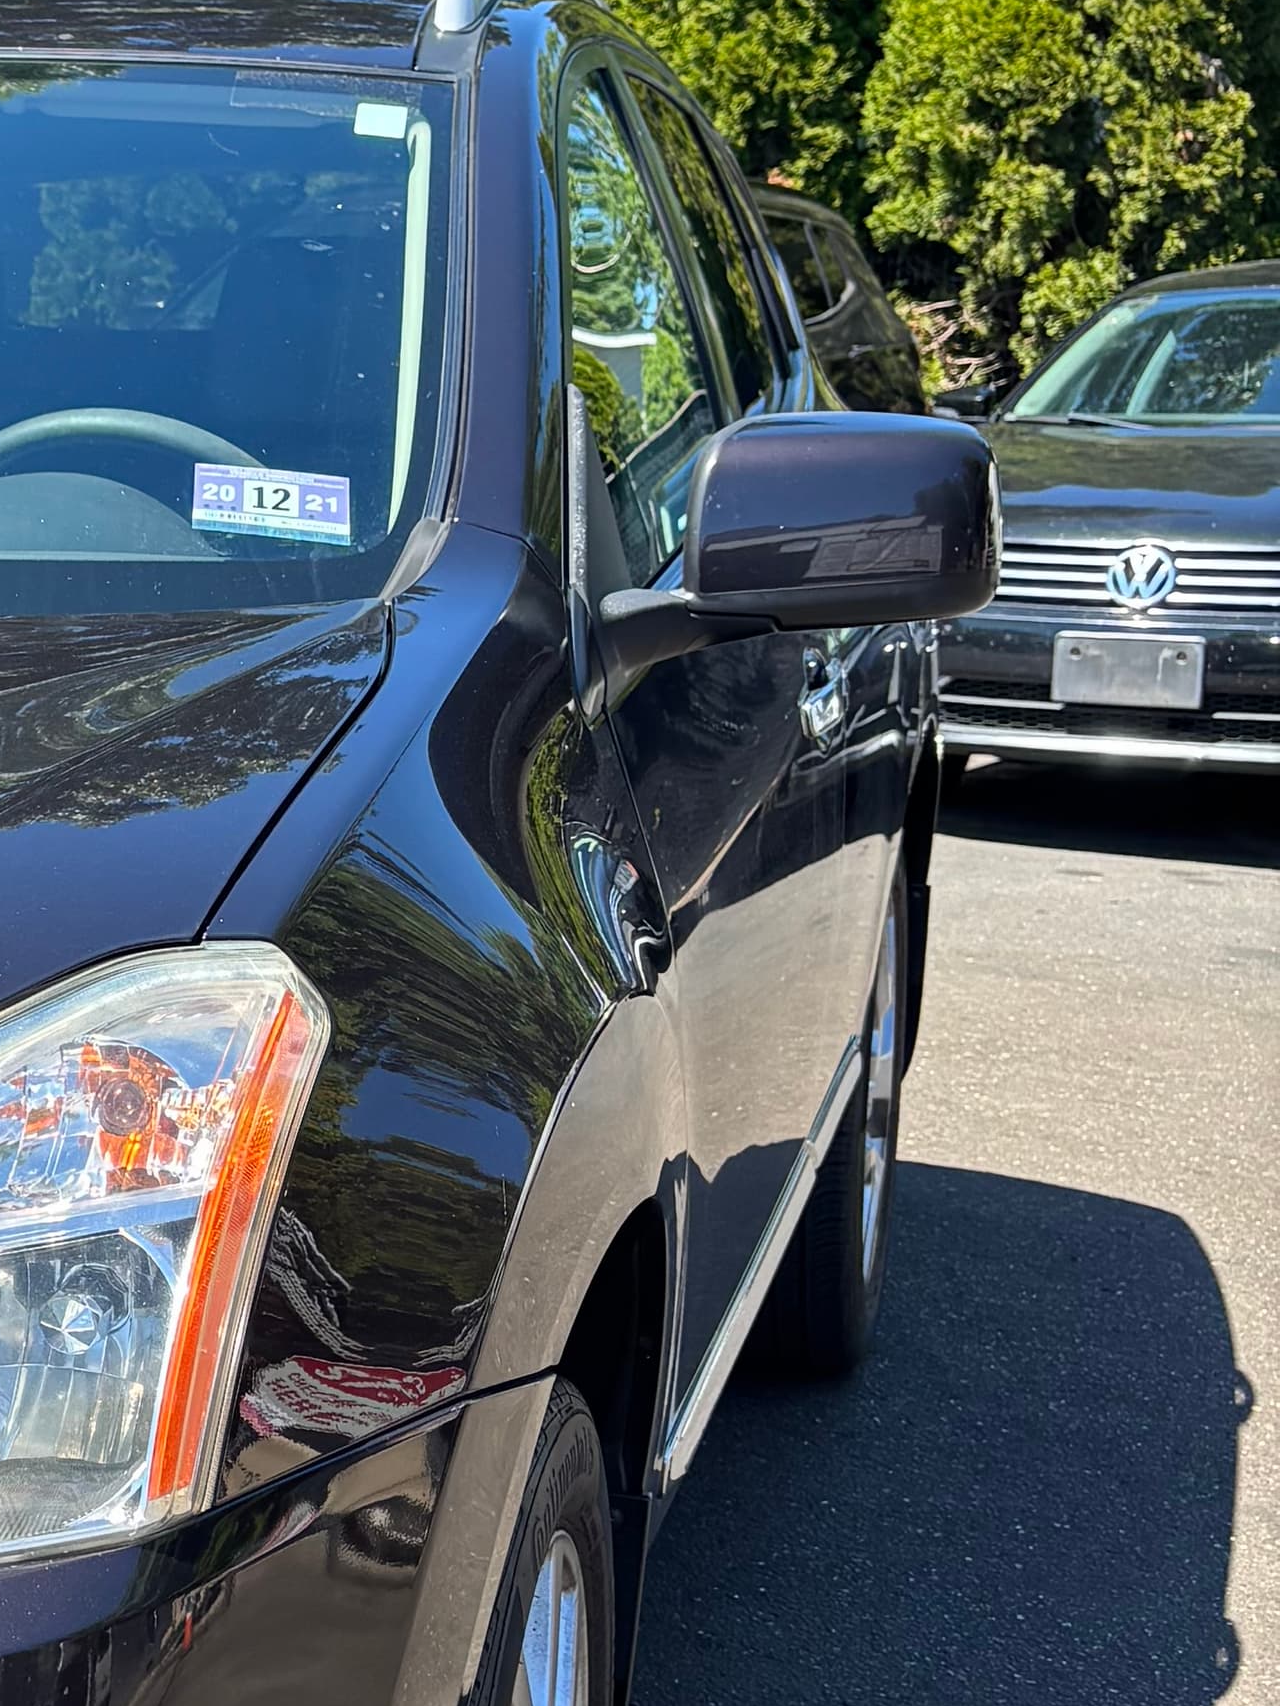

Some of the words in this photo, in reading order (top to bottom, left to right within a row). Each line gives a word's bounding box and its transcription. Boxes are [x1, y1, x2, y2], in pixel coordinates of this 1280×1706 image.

[202, 482, 236, 503] 20
[252, 486, 291, 512] 12
[304, 493, 338, 514] 21
